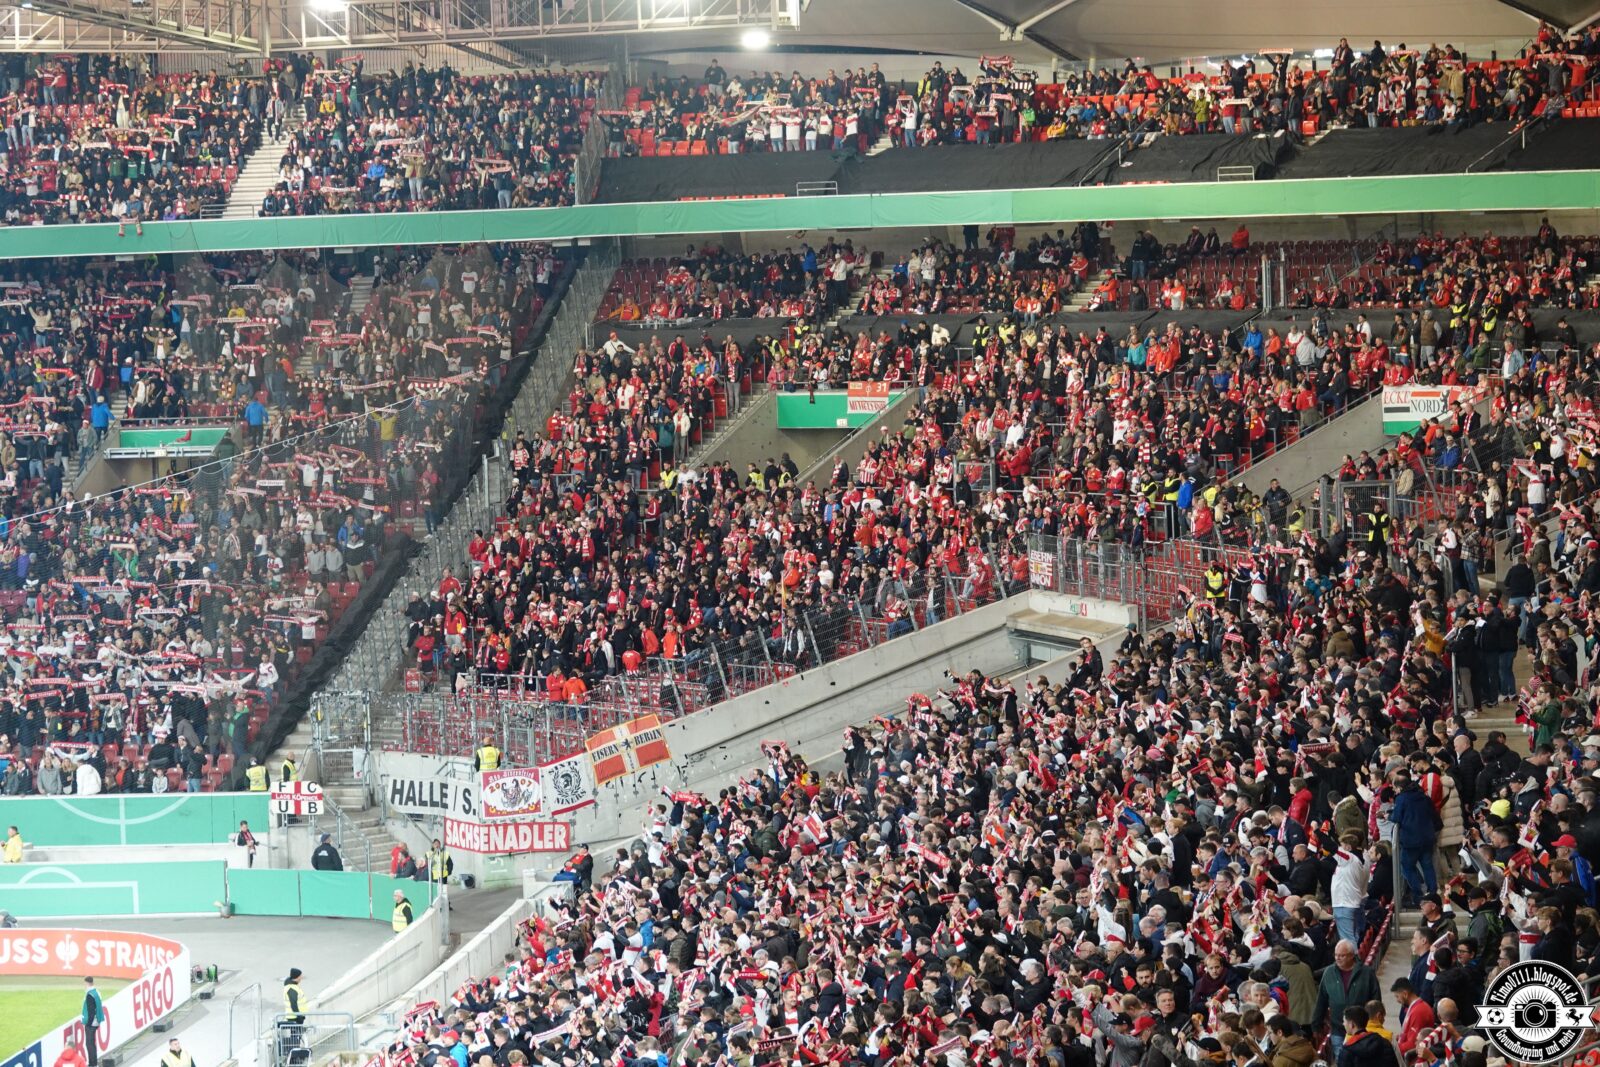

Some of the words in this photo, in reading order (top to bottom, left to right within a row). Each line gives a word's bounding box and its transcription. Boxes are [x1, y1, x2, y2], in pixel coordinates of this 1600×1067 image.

[1383, 390, 1410, 405] ECKE
[1410, 398, 1440, 413] NORD
[591, 743, 619, 762] EISERN
[548, 760, 580, 775] SIXTY
[307, 782, 317, 792] C
[390, 778, 449, 810] HALLE
[462, 787, 477, 816] S.
[554, 788, 587, 805] NINERS
[279, 801, 288, 812] U
[308, 803, 317, 813] B
[445, 819, 567, 851] SACHSENADLER
[132, 966, 174, 1030] ERGO
